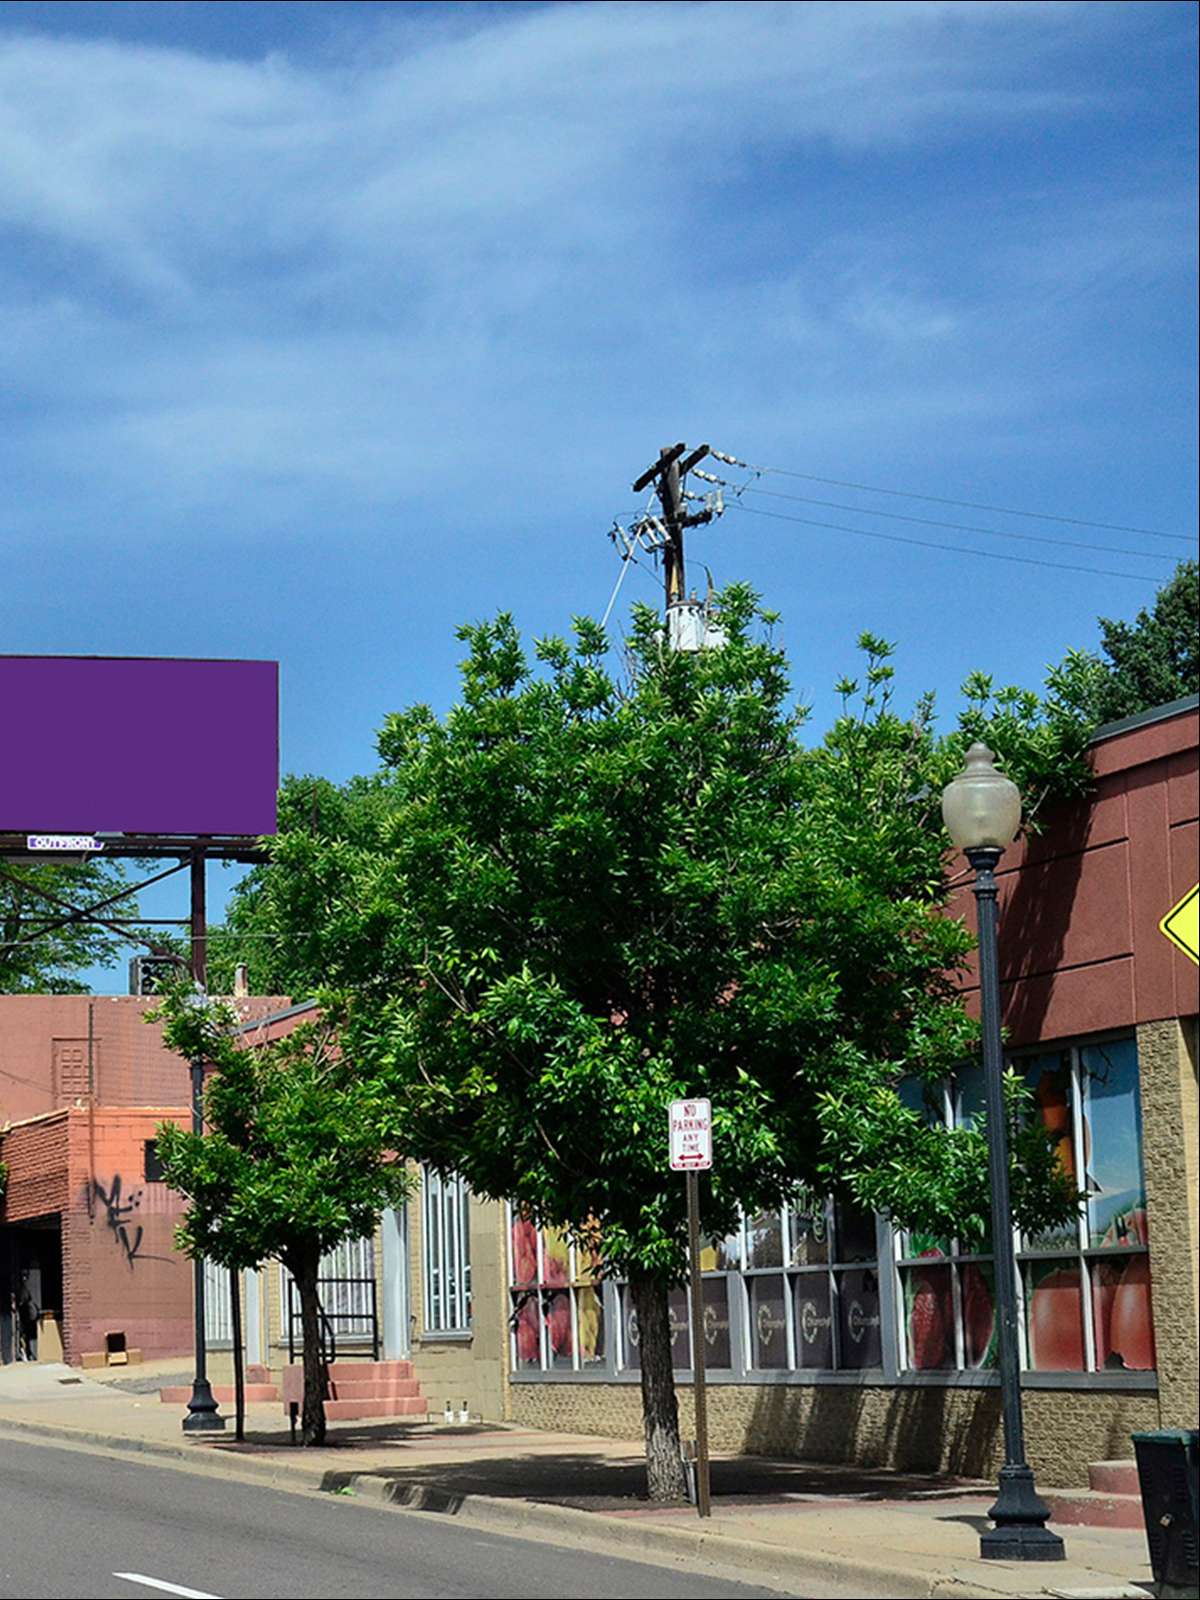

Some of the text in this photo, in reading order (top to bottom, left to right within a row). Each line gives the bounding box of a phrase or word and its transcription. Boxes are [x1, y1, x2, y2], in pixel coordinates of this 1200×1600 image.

[684, 1104, 697, 1117] NO
[673, 1118, 709, 1132] PARKING
[682, 1134, 699, 1142] ANY
[682, 1143, 700, 1153] TIME
